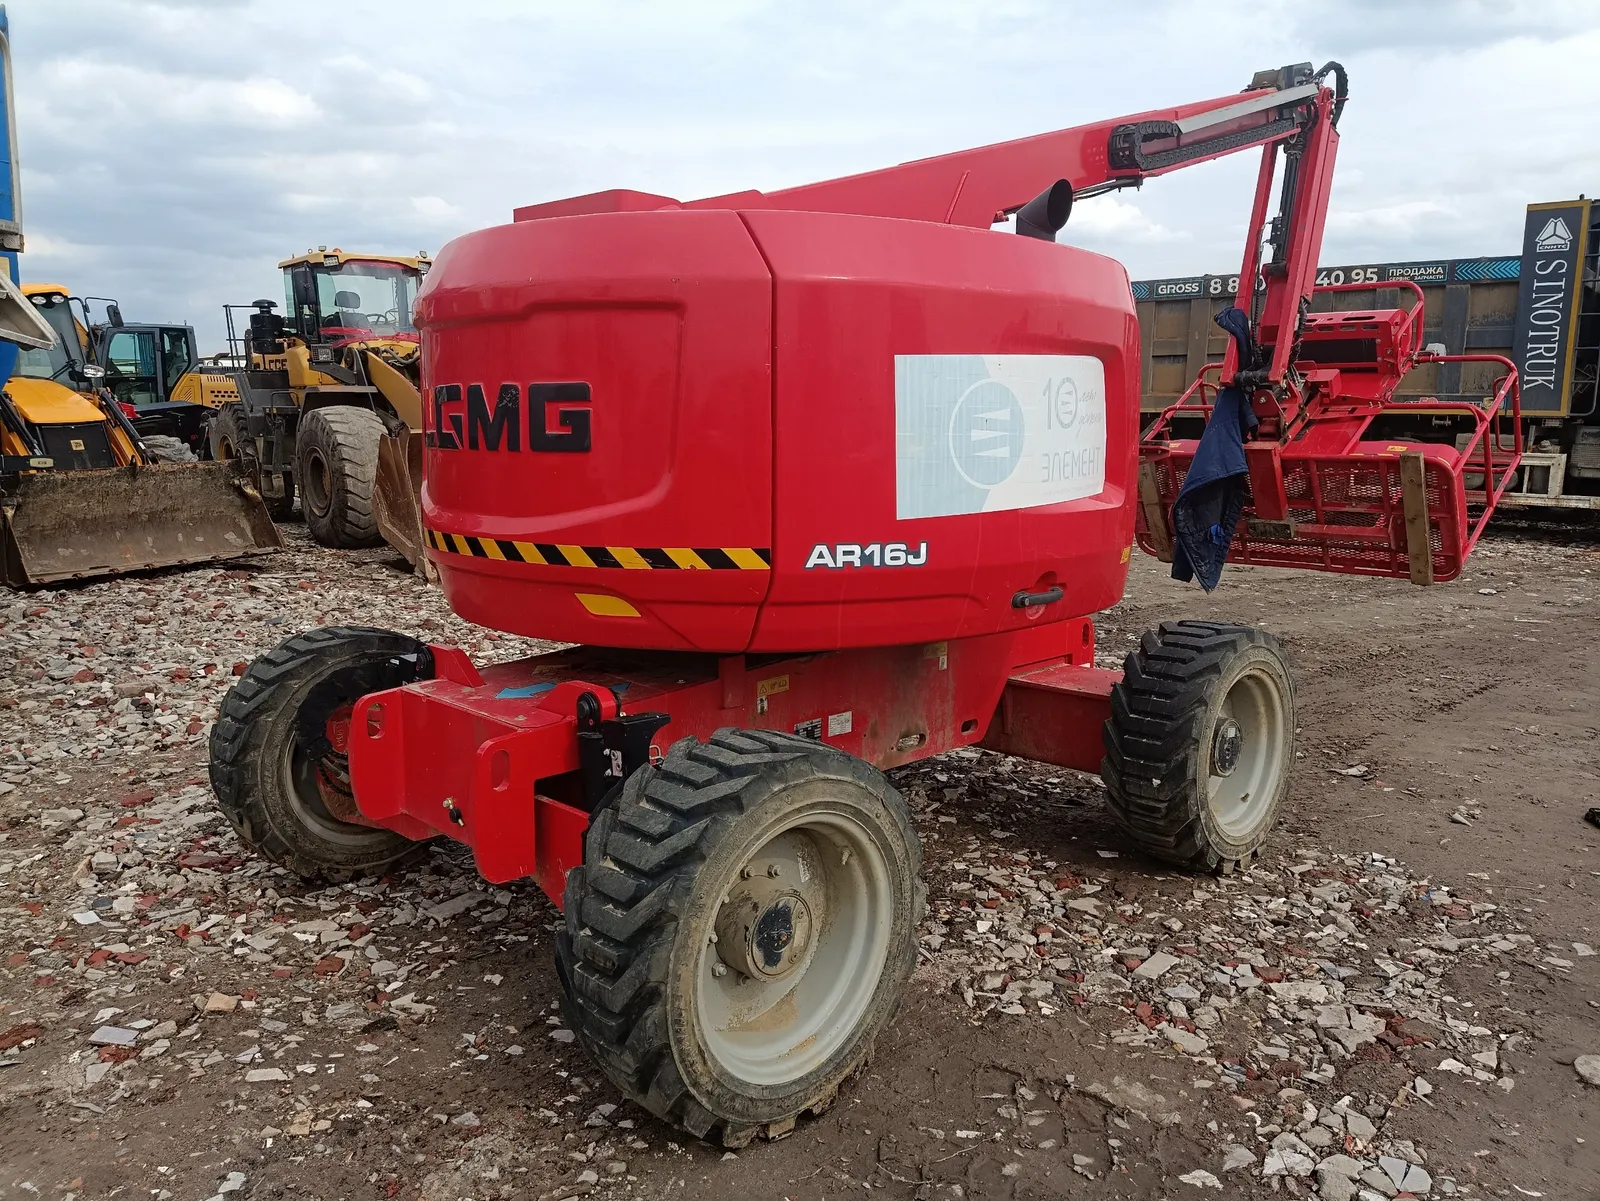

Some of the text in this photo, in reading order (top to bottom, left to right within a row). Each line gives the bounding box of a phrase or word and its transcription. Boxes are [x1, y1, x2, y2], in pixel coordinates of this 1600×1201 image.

[1209, 278, 1222, 294] 8
[1315, 269, 1345, 287] 40
[1351, 267, 1378, 285] 95
[1389, 266, 1444, 277] ПРОДАЖА
[1158, 283, 1199, 295] GROSS
[1523, 258, 1568, 391] SINOTRUK
[1041, 447, 1101, 483] ЭЛЕМЕНТ
[805, 542, 928, 569] AR16J
